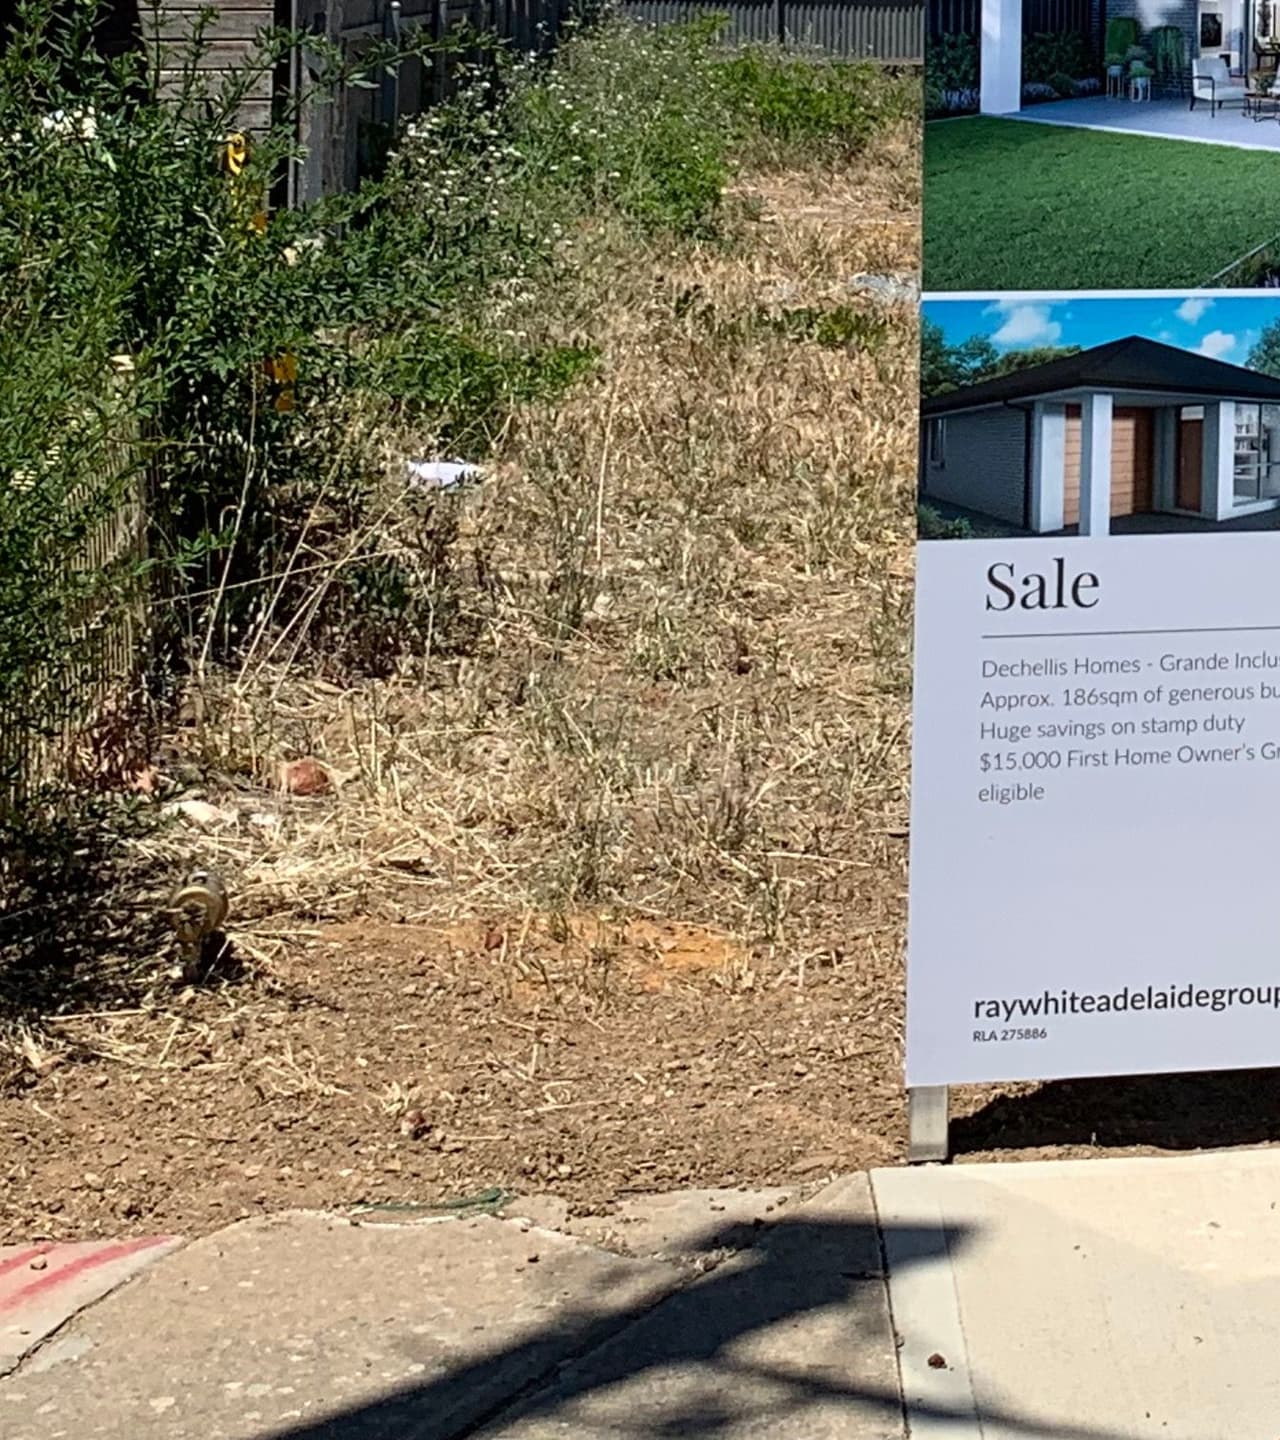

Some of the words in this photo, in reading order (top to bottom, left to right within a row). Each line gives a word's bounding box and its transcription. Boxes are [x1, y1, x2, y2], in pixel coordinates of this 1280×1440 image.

[986, 557, 1099, 611] Sale
[982, 658, 1068, 678] Dechellis
[1074, 657, 1141, 675] Homes
[1160, 653, 1229, 672] Grande
[980, 692, 1054, 712] Approx.
[1064, 688, 1138, 707] 186sqm
[1144, 685, 1163, 703] of
[1168, 687, 1254, 706] generous
[981, 722, 1031, 743] Huge
[1037, 720, 1105, 740] savings
[1111, 721, 1135, 735] on
[1141, 717, 1198, 736] stamp
[1203, 713, 1245, 734] duty
[1068, 750, 1108, 768] First
[1115, 748, 1171, 766] Home
[1177, 743, 1255, 763] Owner's
[978, 783, 1045, 805] eligible
[973, 1030, 998, 1042] RLA
[1001, 1028, 1047, 1041] 275886
